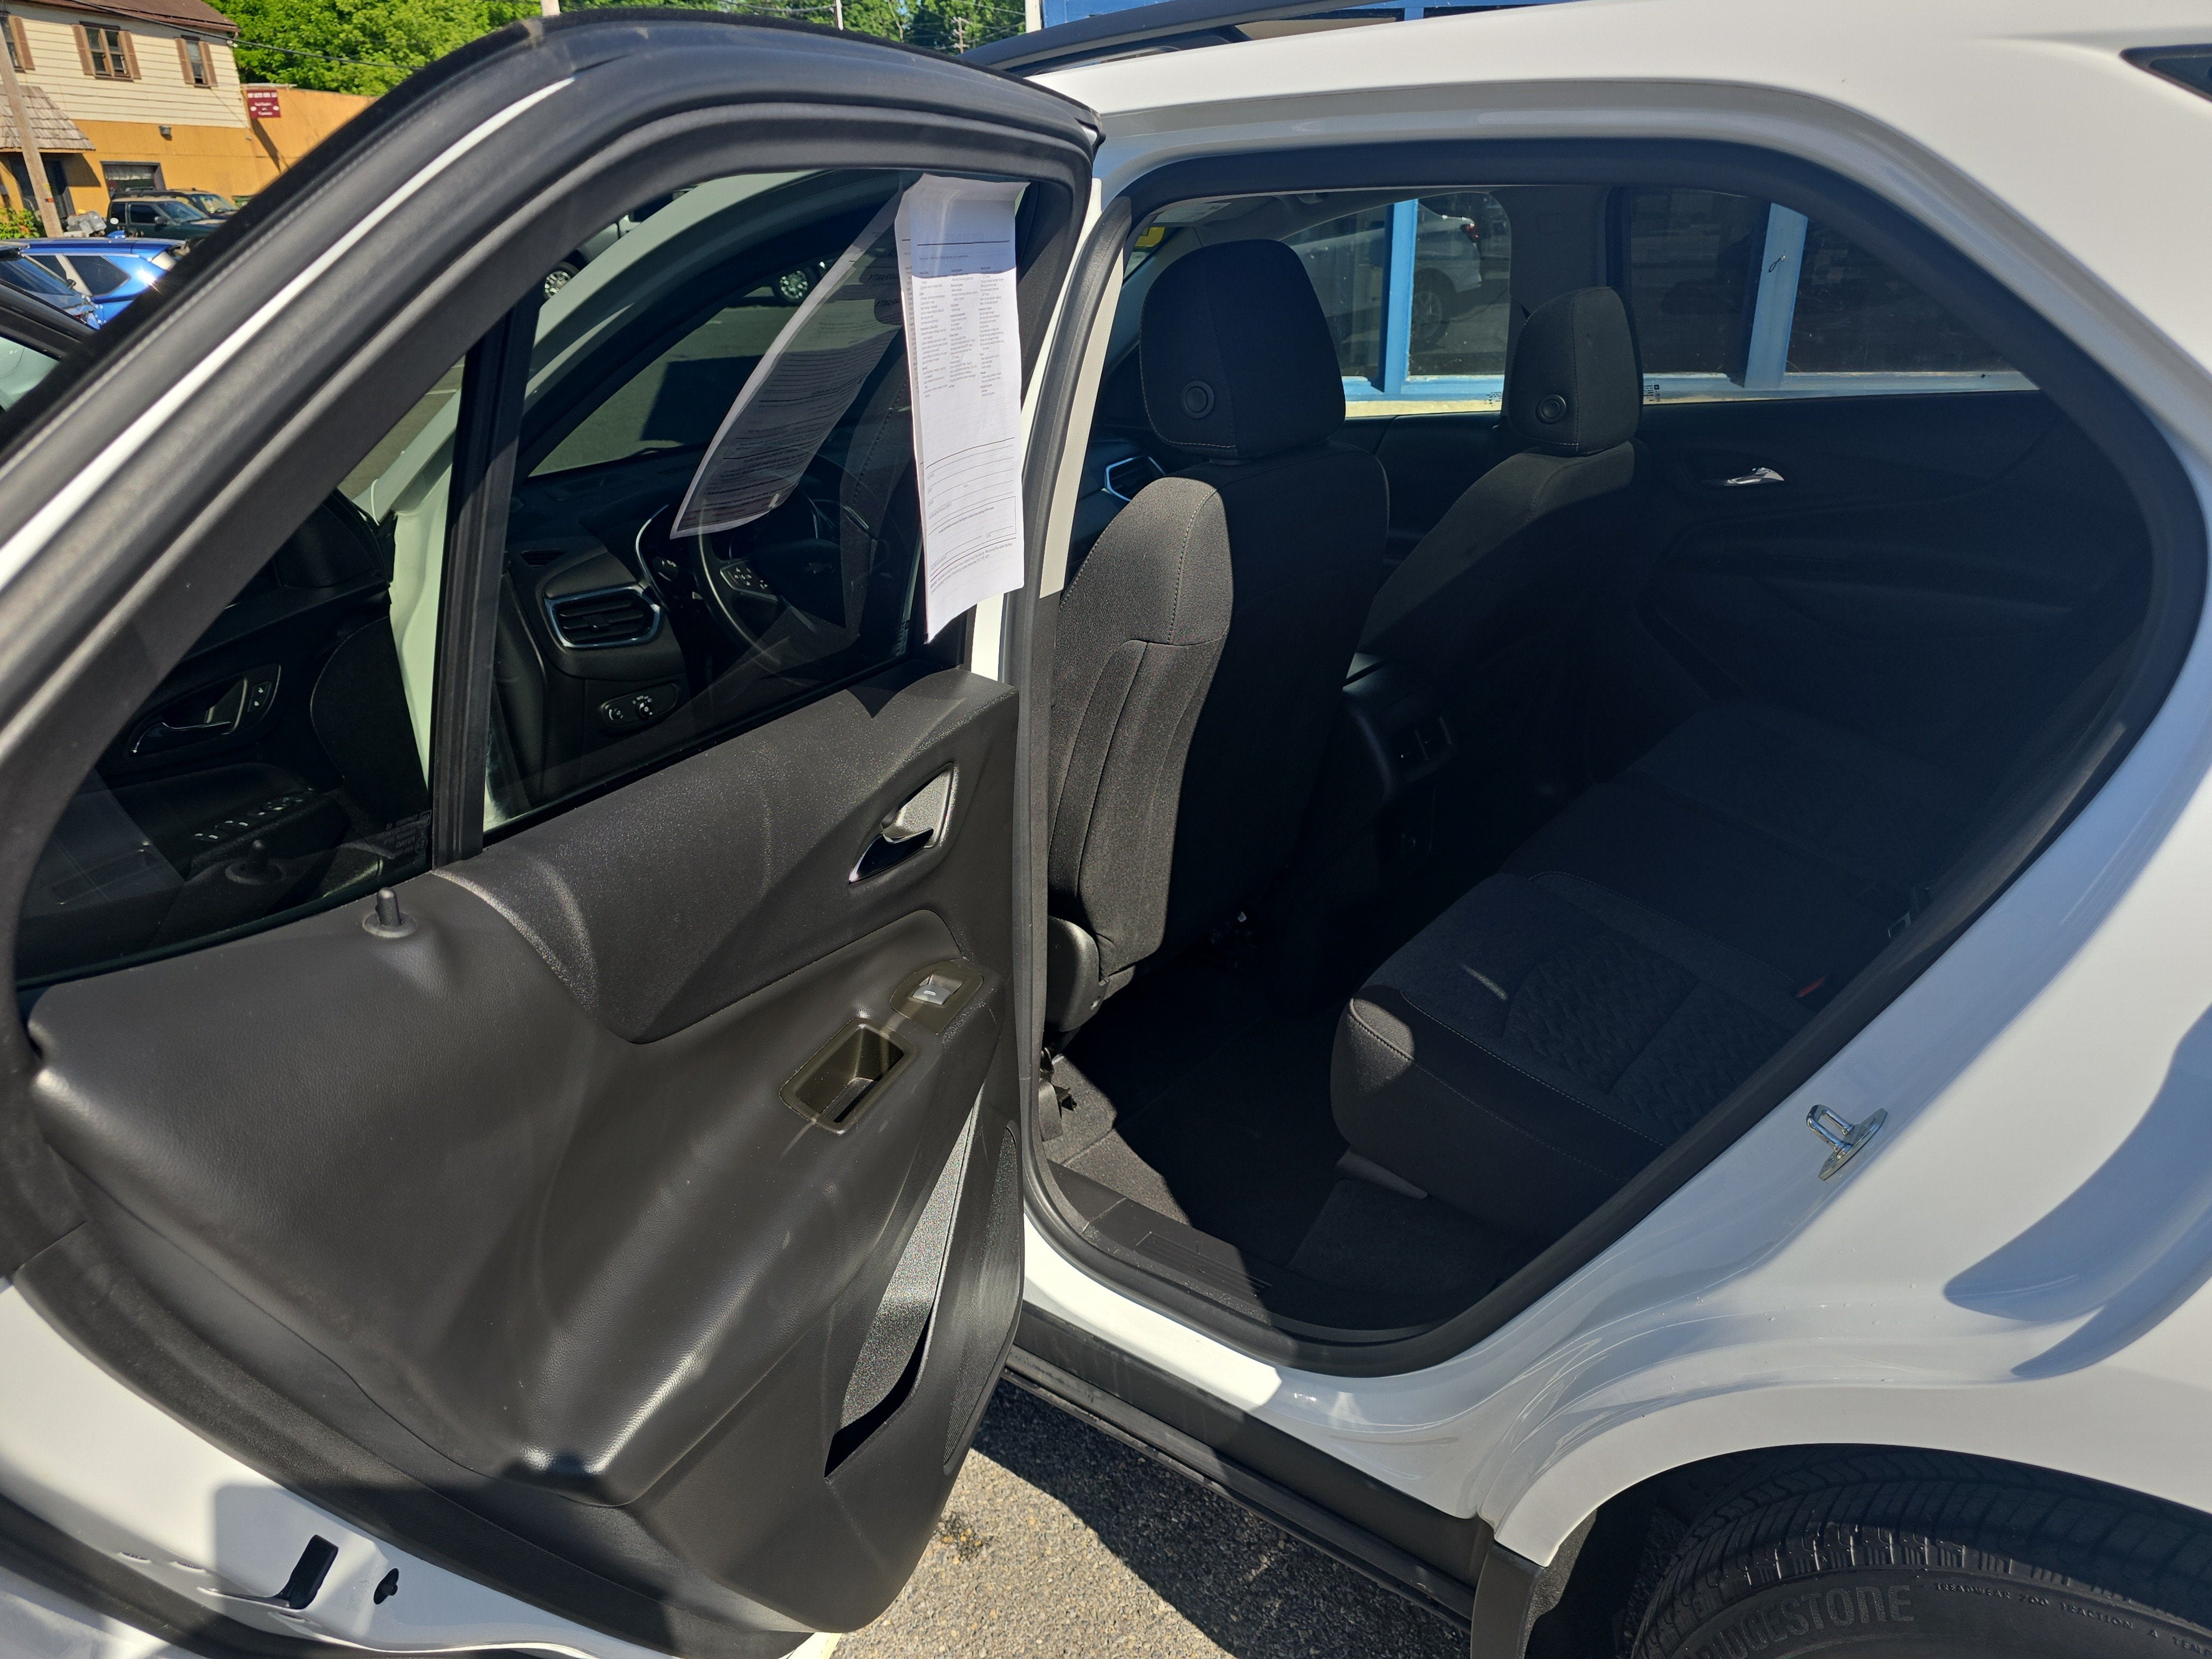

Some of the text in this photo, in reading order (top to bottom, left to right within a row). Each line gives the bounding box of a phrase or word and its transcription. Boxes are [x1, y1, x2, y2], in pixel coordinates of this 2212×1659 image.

[1684, 1585, 1915, 1659] IDGESTONE
[1934, 1583, 2011, 1600] TREADWEAR
[2059, 1601, 2134, 1630] TRACTION
